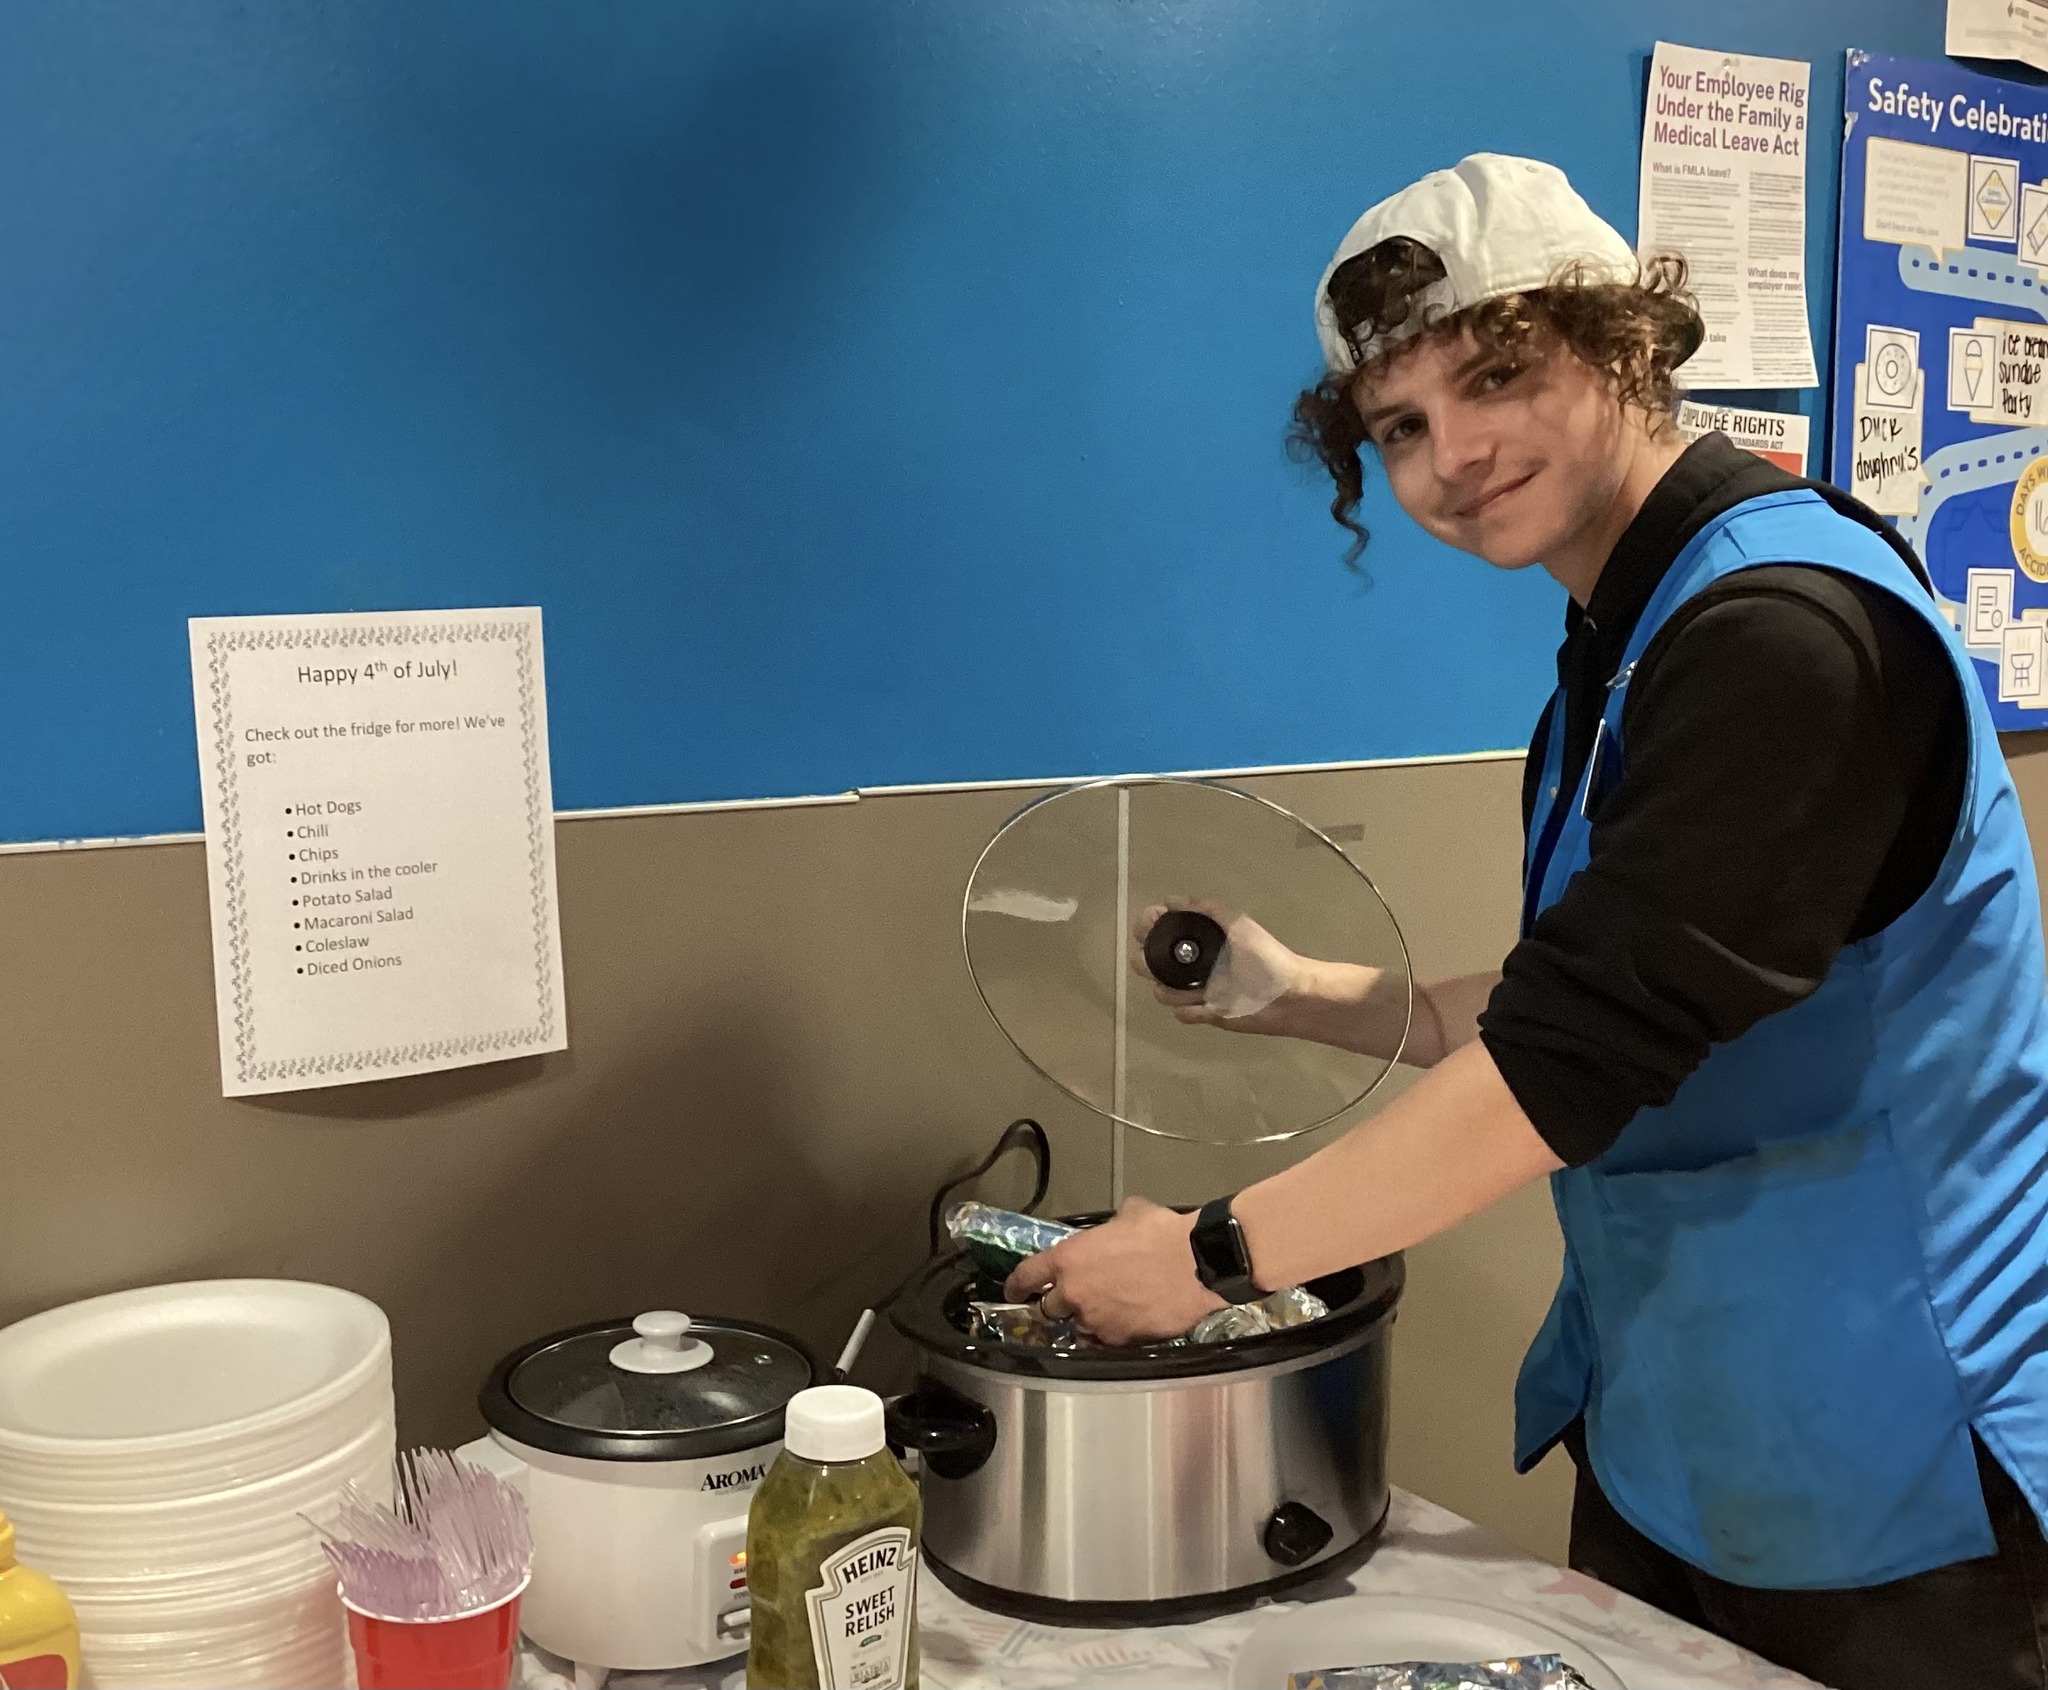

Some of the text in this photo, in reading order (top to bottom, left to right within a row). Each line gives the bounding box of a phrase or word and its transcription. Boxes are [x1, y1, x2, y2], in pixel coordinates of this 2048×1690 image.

[1660, 65, 1805, 108] Your Employee Rig
[1656, 93, 1804, 133] Under the Family a
[1868, 77, 2048, 144] Safety Celebrati
[1653, 121, 1800, 156] Medical Leave Act
[1652, 161, 1732, 178] What is FMLA leave?
[1747, 267, 1800, 281] What does my
[1747, 281, 1784, 292] employer
[1709, 332, 1727, 343] take
[1681, 407, 1729, 432] EMPLOYEE
[1732, 415, 1785, 437] RIGHTS
[1769, 440, 1784, 450] ACT
[2015, 473, 2036, 516] DAYS
[2018, 547, 2048, 576] ACCID
[298, 659, 458, 686] Happy 4th of July!
[245, 714, 506, 742] Check out the fridge for more! We've
[246, 751, 277, 768] got:
[295, 801, 362, 816] Hot Dogs
[298, 847, 339, 863] Chips
[301, 861, 438, 885] Drinks in the cooler
[302, 886, 393, 908] Potato Salad
[304, 907, 414, 930] Macaroni Salad
[305, 936, 370, 953] Coleslaw
[307, 956, 402, 976] Diced Onions
[700, 1463, 766, 1492] AROMA
[842, 1547, 897, 1584] HEINZ
[845, 1585, 895, 1619] SWEET
[845, 1603, 895, 1638] RELISH
